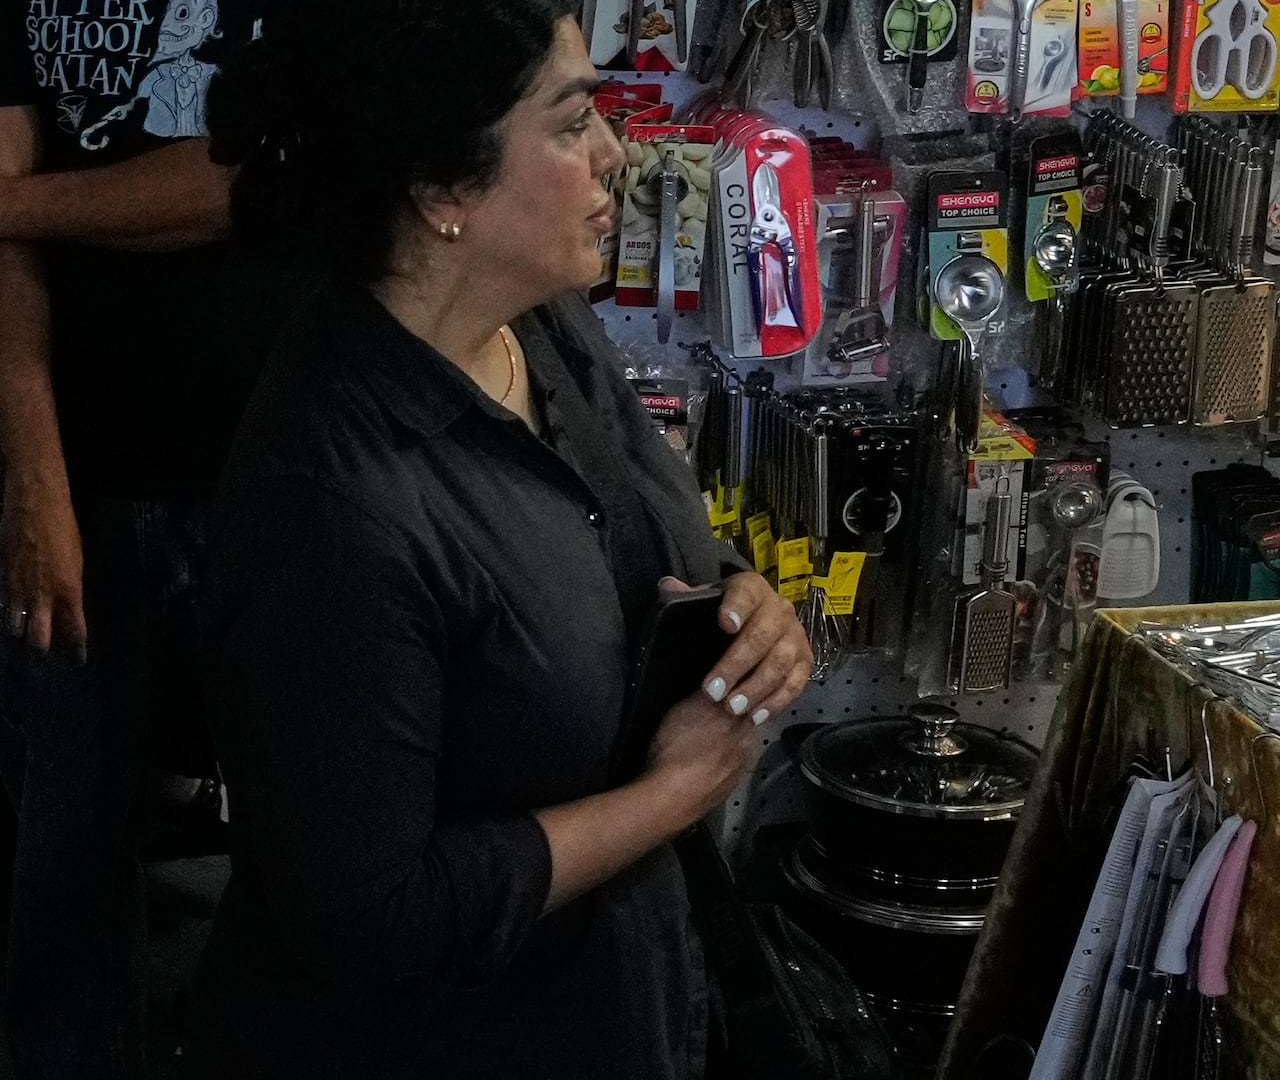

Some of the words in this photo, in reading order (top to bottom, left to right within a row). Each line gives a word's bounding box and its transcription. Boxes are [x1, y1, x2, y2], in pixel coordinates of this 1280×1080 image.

[25, 15, 151, 58] SCHOOL
[33, 52, 141, 95] SATAN
[1038, 173, 1052, 181] TOP
[1053, 169, 1076, 180] CHOICE
[726, 183, 748, 276] CORAL
[940, 209, 958, 217] TOP
[961, 207, 995, 217] CHOICE
